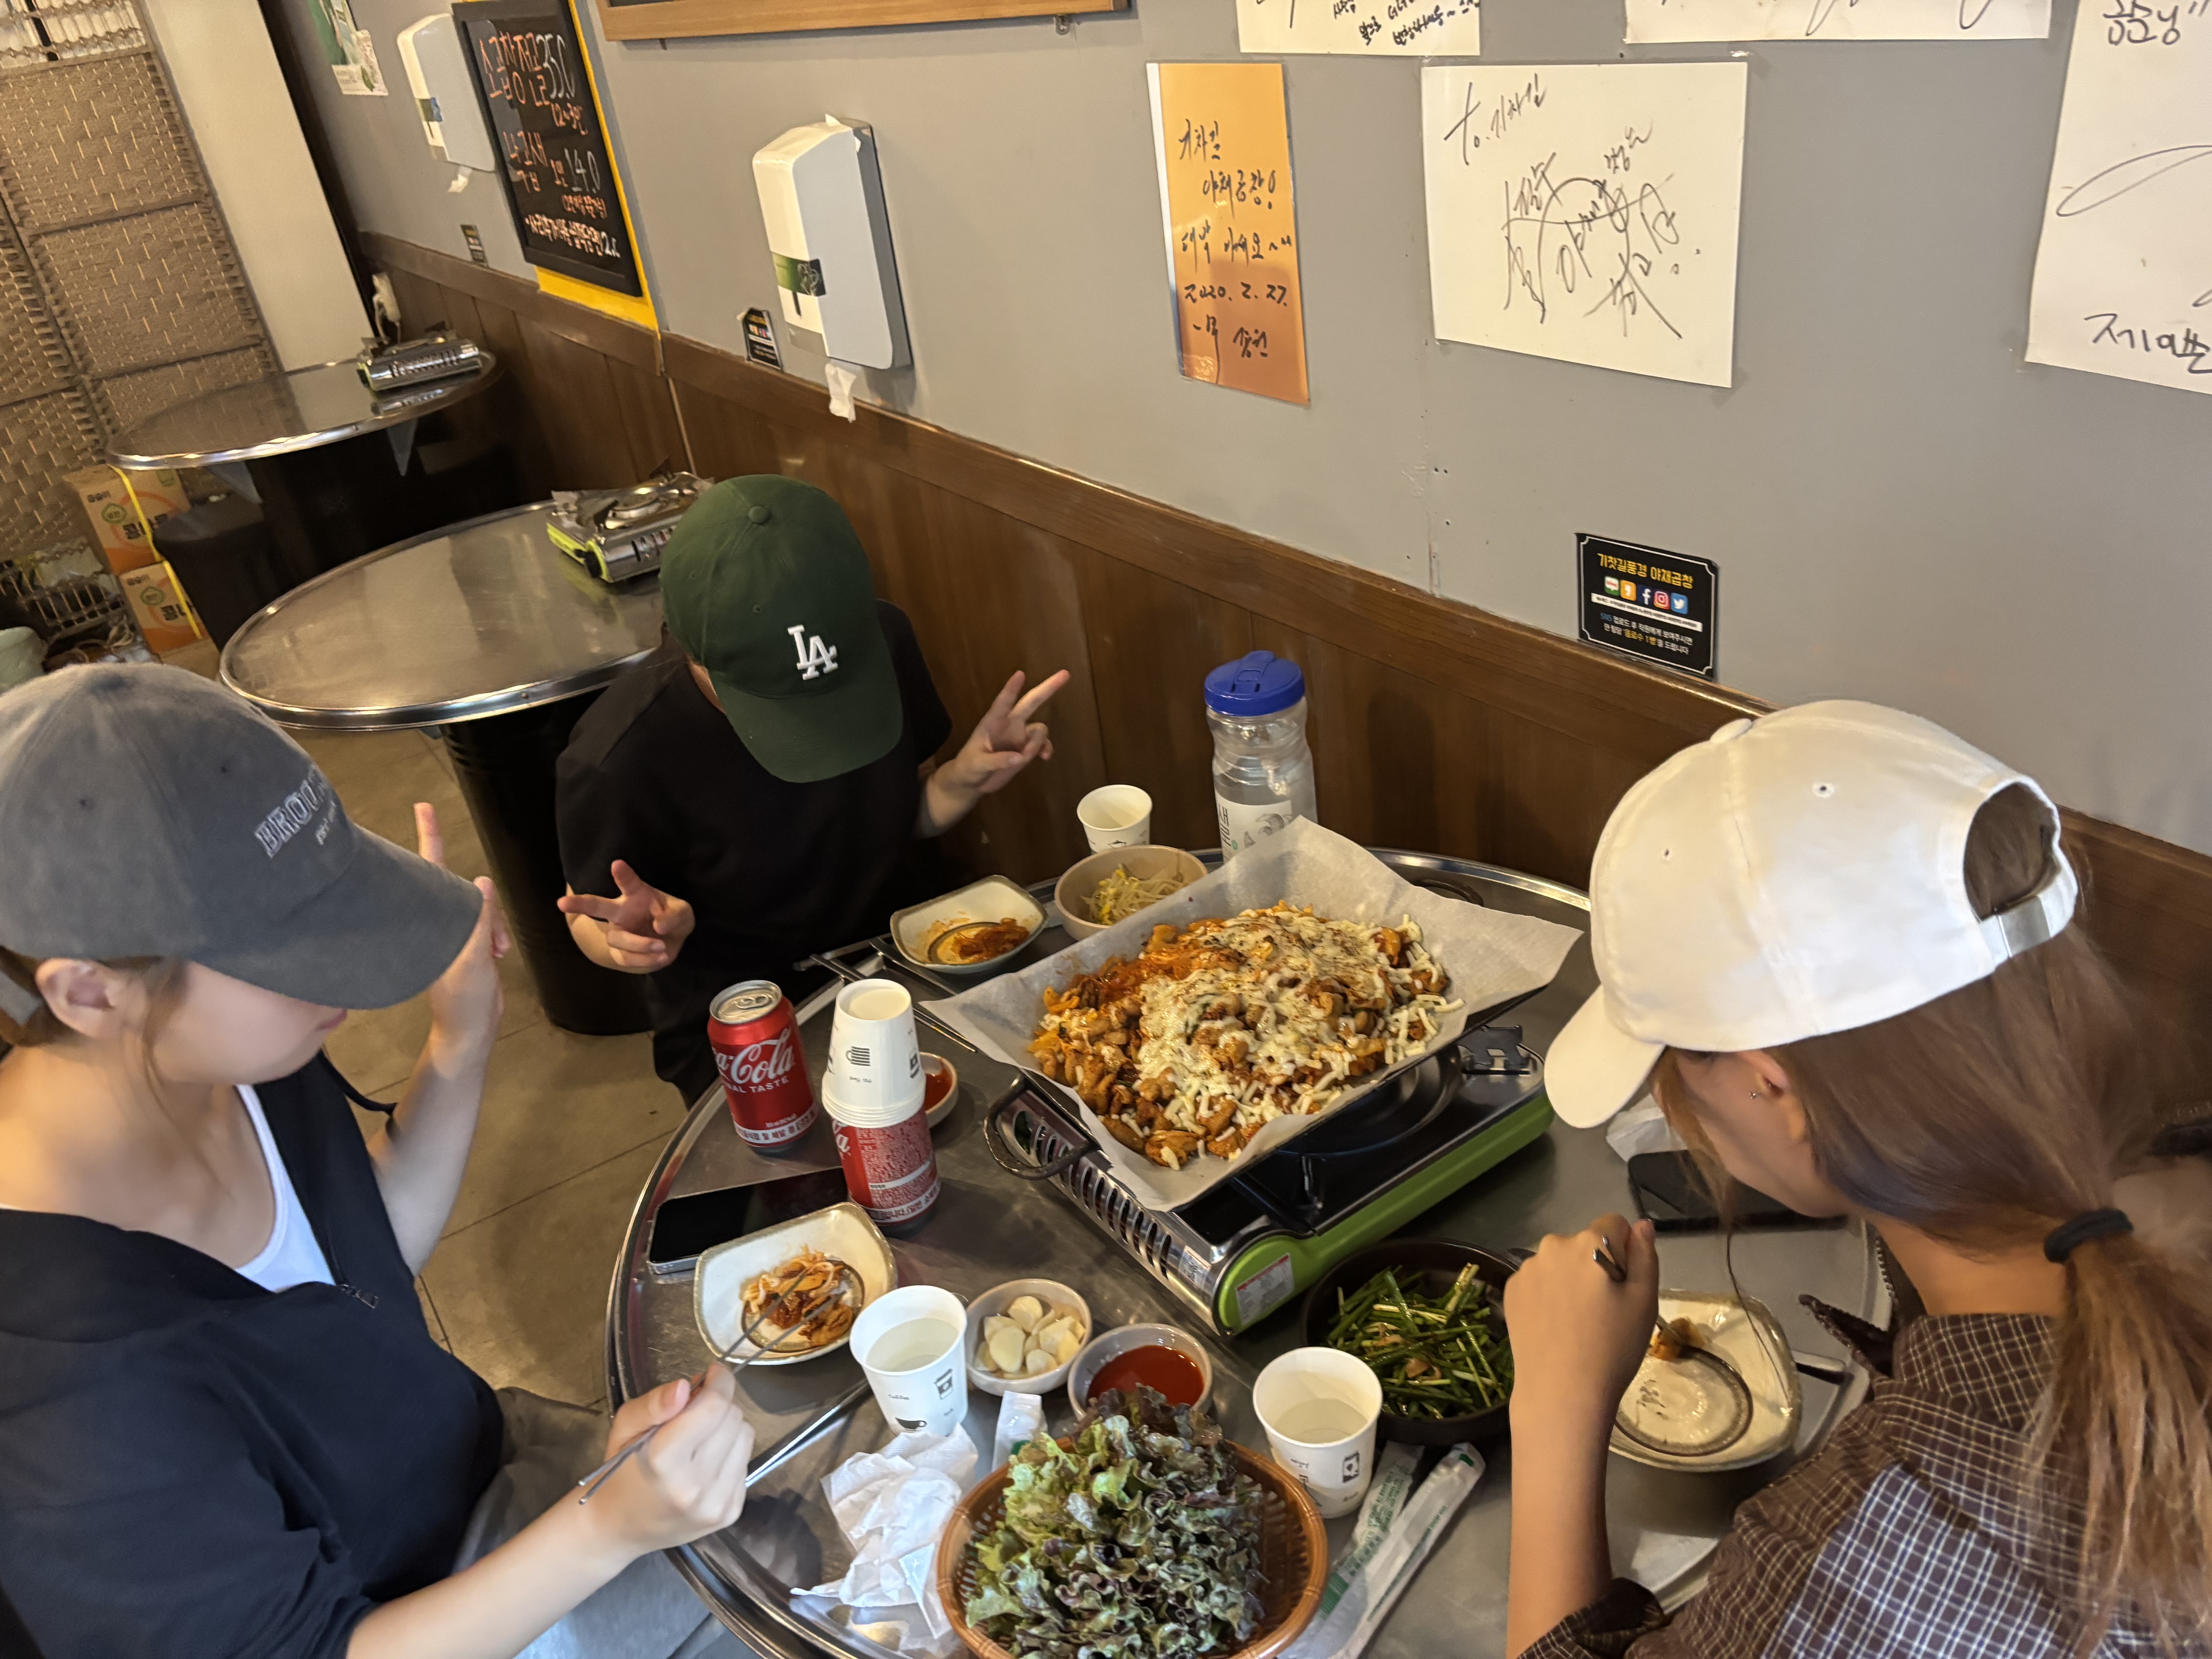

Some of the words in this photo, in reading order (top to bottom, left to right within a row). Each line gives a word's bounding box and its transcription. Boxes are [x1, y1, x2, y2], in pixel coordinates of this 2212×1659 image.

[536, 33, 575, 99] 35.0
[503, 131, 548, 194] 낙곱새
[564, 148, 601, 194] 14.0
[1240, 282, 1258, 299] 2.
[1266, 284, 1288, 307] 27.
[1597, 553, 1648, 577] 기찻길풍경
[1650, 566, 1694, 589] 야채곱창
[787, 625, 838, 680] LA
[711, 1028, 795, 1084] a-Cola
